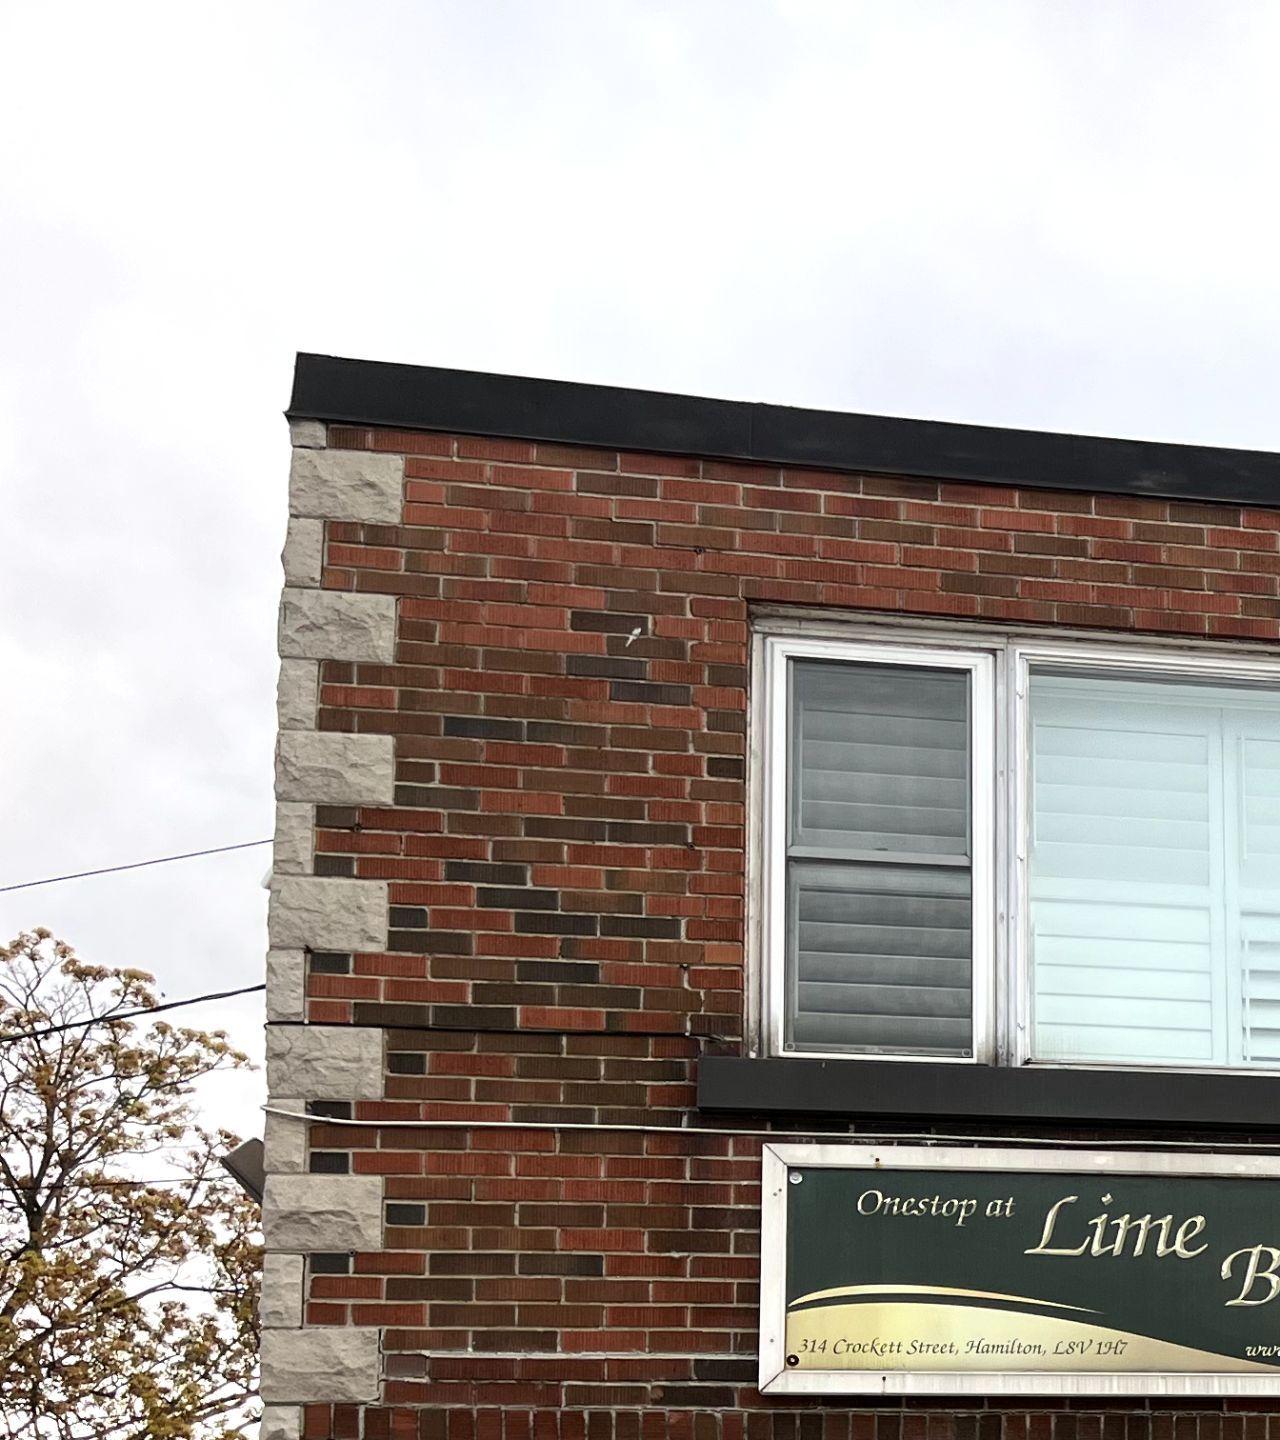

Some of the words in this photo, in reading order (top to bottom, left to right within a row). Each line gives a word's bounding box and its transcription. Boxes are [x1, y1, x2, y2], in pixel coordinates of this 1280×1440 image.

[856, 1189, 977, 1226] Onestop
[984, 1196, 1016, 1219] at
[1023, 1193, 1208, 1260] Lime
[798, 1339, 826, 1354] 314
[833, 1337, 901, 1358] Crockett
[906, 1338, 959, 1356] Street,
[965, 1338, 1047, 1357] Hamilton,
[1052, 1339, 1093, 1355] L8V
[1095, 1340, 1128, 1356] 1H7
